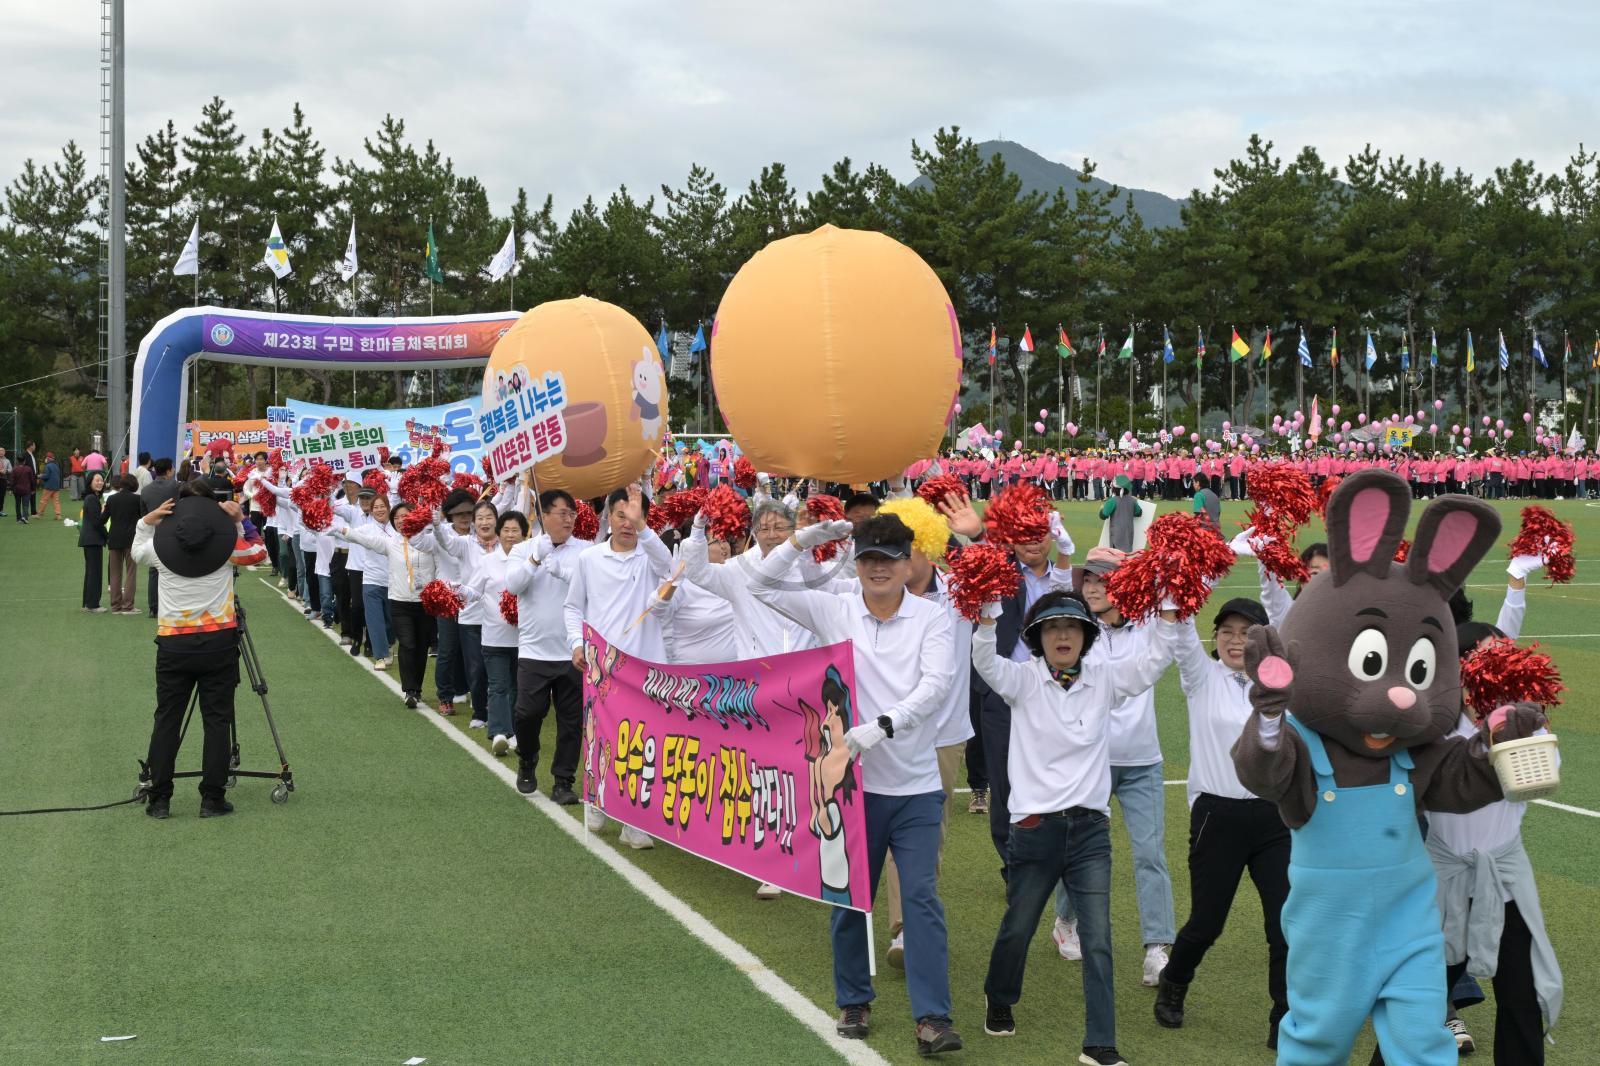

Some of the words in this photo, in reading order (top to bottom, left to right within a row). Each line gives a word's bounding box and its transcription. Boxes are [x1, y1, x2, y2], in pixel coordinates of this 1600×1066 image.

[263, 332, 316, 350] 제23회
[323, 334, 354, 352] 구민
[360, 333, 468, 352] 한마음체육대회
[479, 399, 520, 444] 행복을
[519, 378, 563, 421] 나누는
[292, 433, 336, 455] 나눔과
[338, 427, 385, 451] 힐링의
[348, 451, 376, 469] 동네
[492, 430, 532, 476] 따뜻한
[532, 415, 563, 455] 달동
[614, 718, 656, 808] 우승은
[662, 733, 717, 831] 달동이
